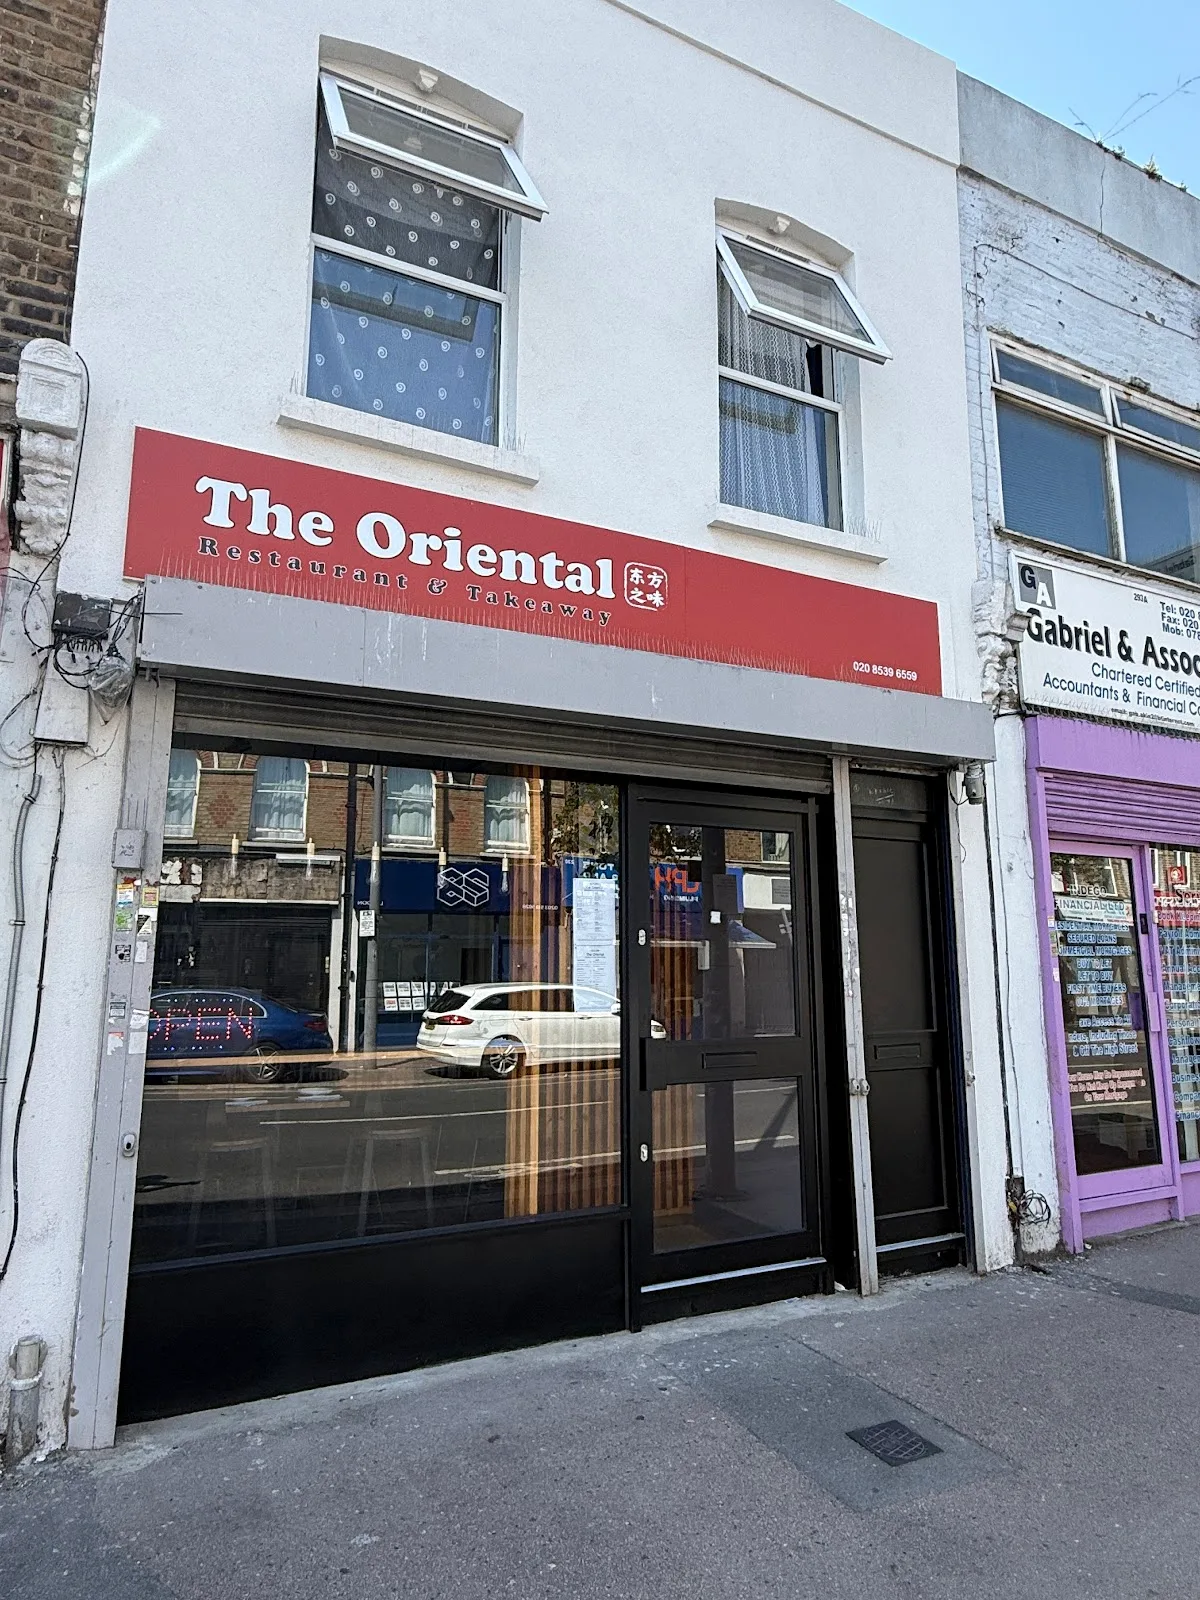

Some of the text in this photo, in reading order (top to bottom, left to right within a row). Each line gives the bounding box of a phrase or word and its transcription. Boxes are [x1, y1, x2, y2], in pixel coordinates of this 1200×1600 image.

[195, 475, 616, 600] The Oriental
[197, 536, 612, 627] Restaurant & Takeaway
[1160, 601, 1195, 619] Tel: 020
[1161, 612, 1199, 630] Fax: 020
[1026, 607, 1112, 660] Gabriel
[1117, 629, 1136, 664] &
[1162, 623, 1184, 636] Mob:
[853, 661, 917, 681] 020 8539 6559
[1091, 662, 1152, 688] Chartered
[1043, 672, 1119, 701] Accountants
[1122, 688, 1131, 703] &
[1137, 691, 1186, 714] Financial
